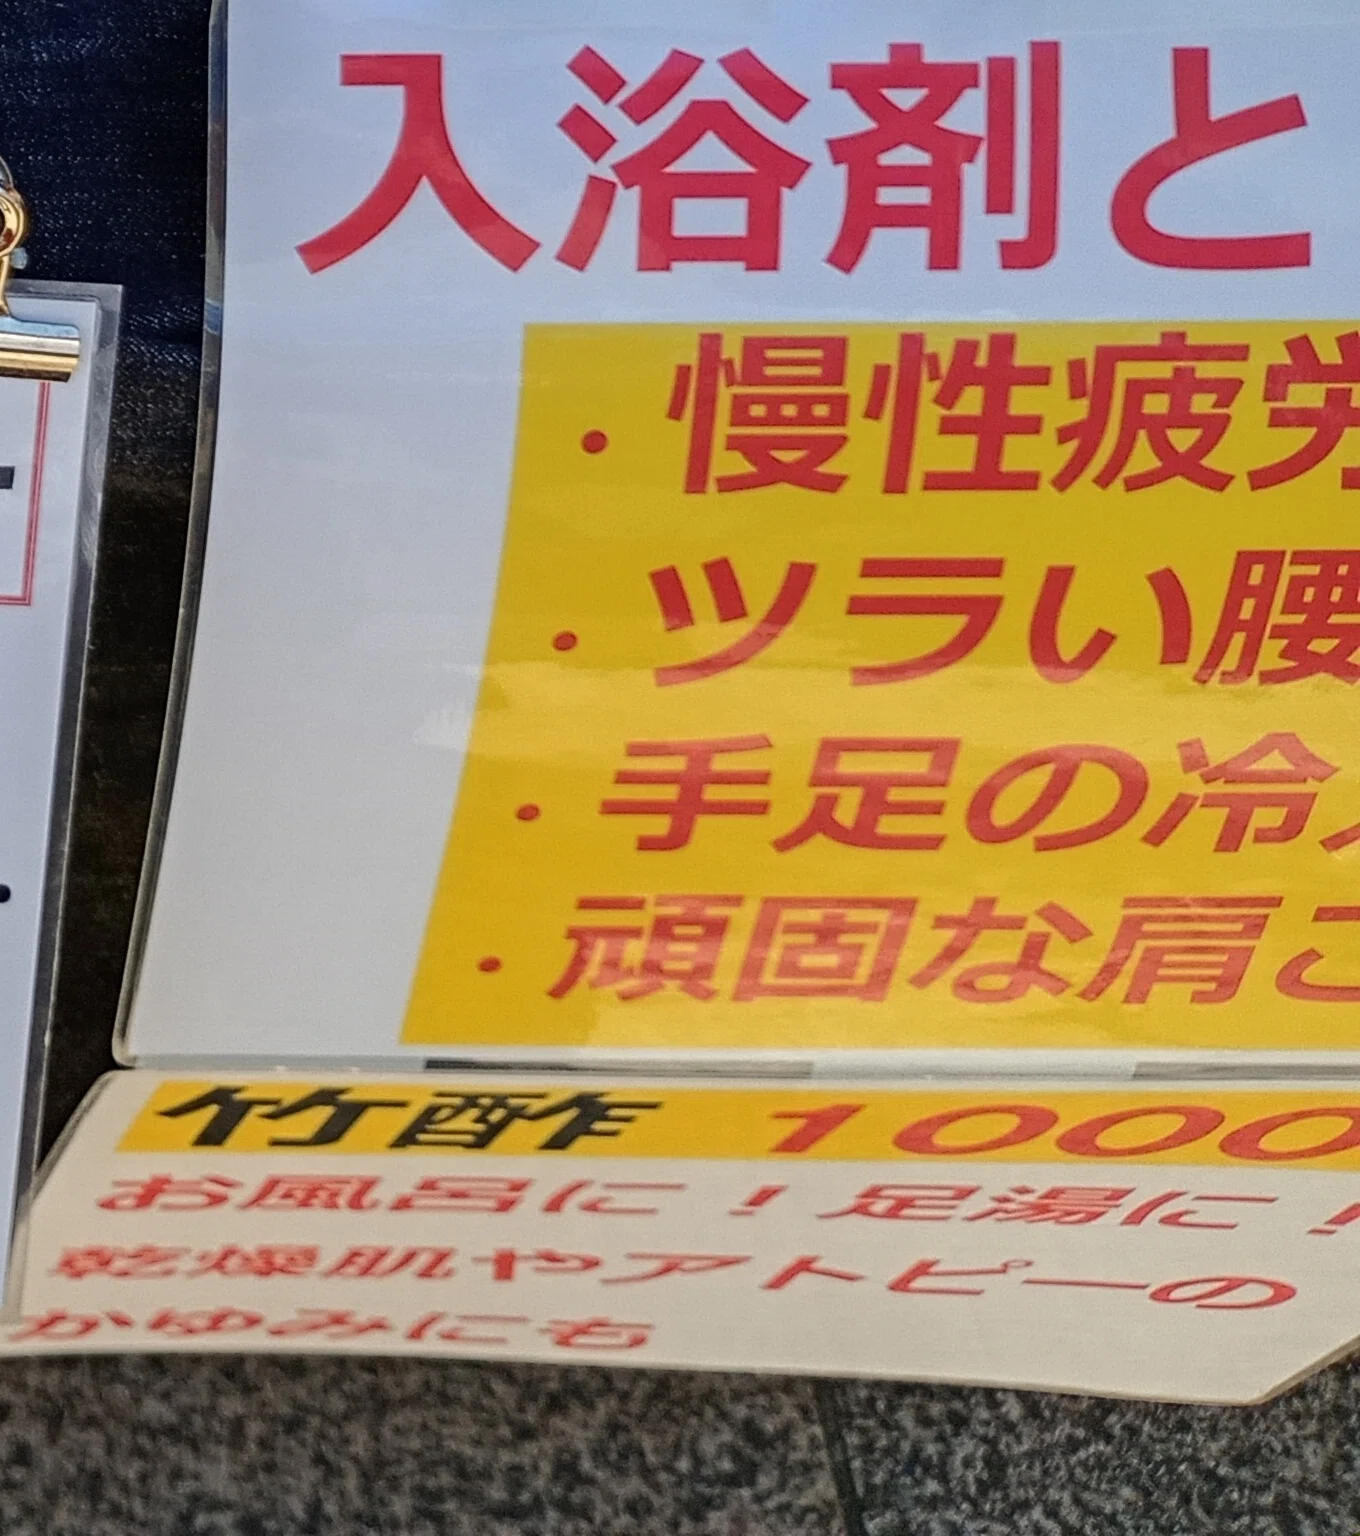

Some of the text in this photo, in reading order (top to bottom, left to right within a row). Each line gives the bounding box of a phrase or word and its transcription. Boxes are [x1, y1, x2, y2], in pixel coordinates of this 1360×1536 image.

[294, 40, 1312, 277] 入浴剤と
[598, 730, 1360, 857] 手足の冷
[154, 1084, 667, 1153] 竹酢
[51, 1245, 1298, 1310] 乾燥肌やアトピーの
[7, 1306, 655, 1351] かゆみにも
